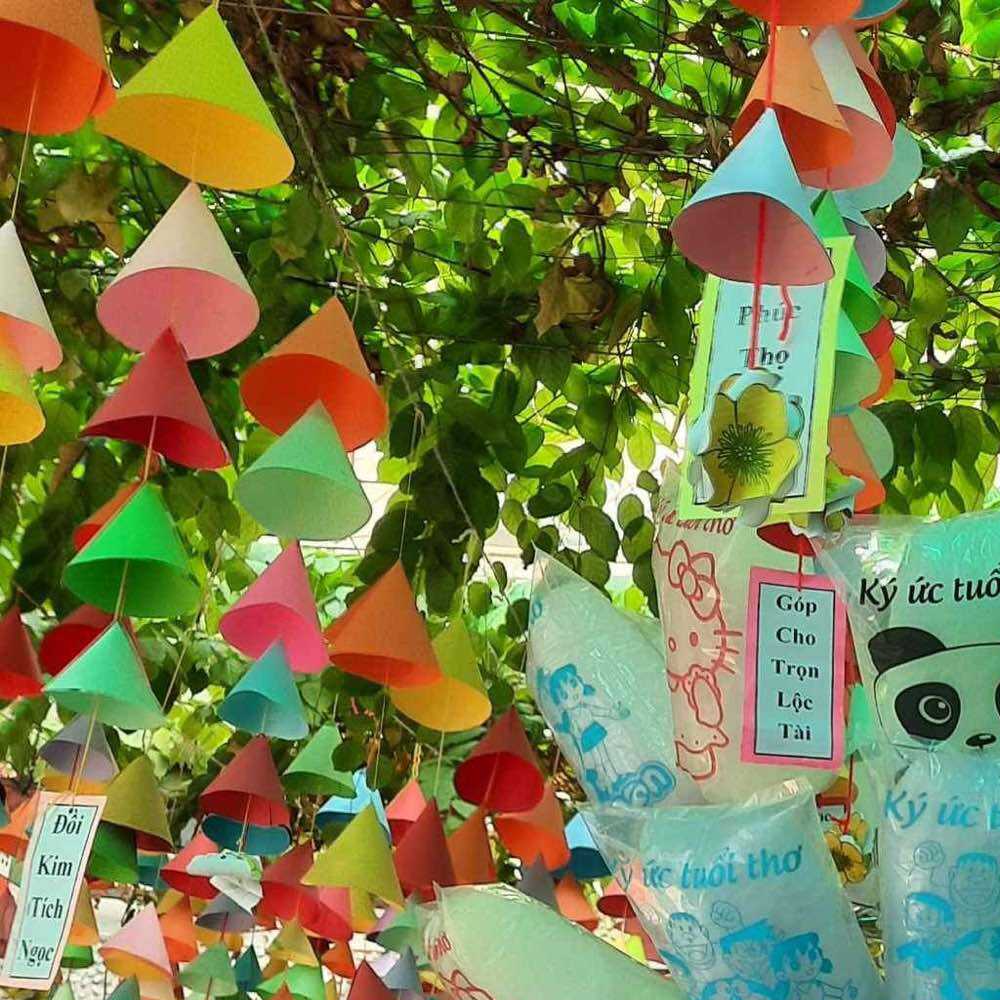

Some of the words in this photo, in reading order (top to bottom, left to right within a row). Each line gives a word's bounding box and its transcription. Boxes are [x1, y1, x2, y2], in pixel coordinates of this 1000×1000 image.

[738, 348, 790, 371] Thọ
[775, 593, 818, 616] Góp
[859, 577, 898, 612] Ký
[907, 576, 944, 604] ức
[775, 626, 817, 647] Cho
[771, 658, 820, 681] Trọn
[777, 691, 814, 713] Lộc
[778, 722, 812, 741] Tài
[883, 789, 928, 829] Ký
[937, 795, 980, 828] ức
[37, 855, 72, 876] Kim
[743, 845, 802, 880] thơ
[32, 897, 63, 919] Tích
[19, 939, 54, 967] Ngọc
